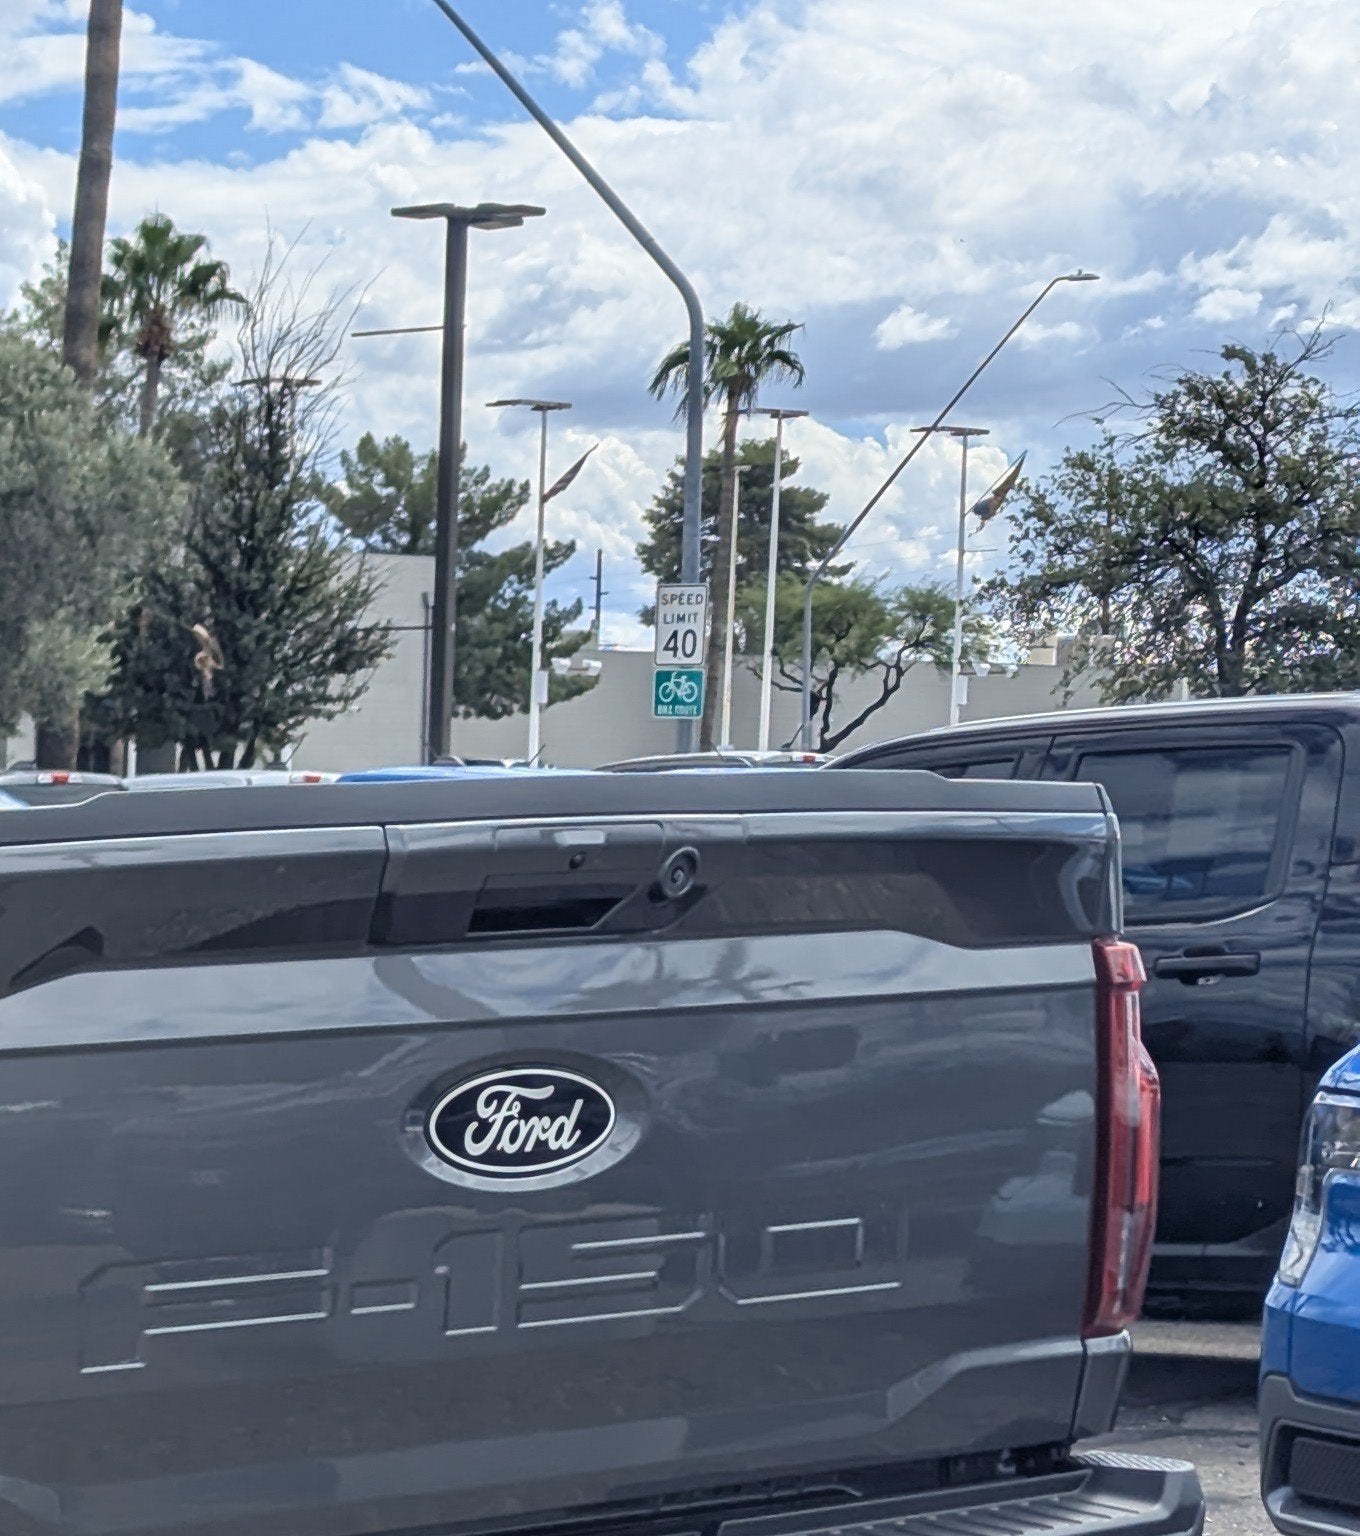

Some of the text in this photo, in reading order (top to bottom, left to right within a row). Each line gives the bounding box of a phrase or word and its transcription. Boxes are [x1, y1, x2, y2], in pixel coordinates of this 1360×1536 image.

[661, 593, 704, 606] SPEED
[663, 612, 698, 625] LIMIT
[662, 629, 697, 658] 40
[464, 1084, 584, 1156] Ford
[79, 1204, 910, 1374] F-150
